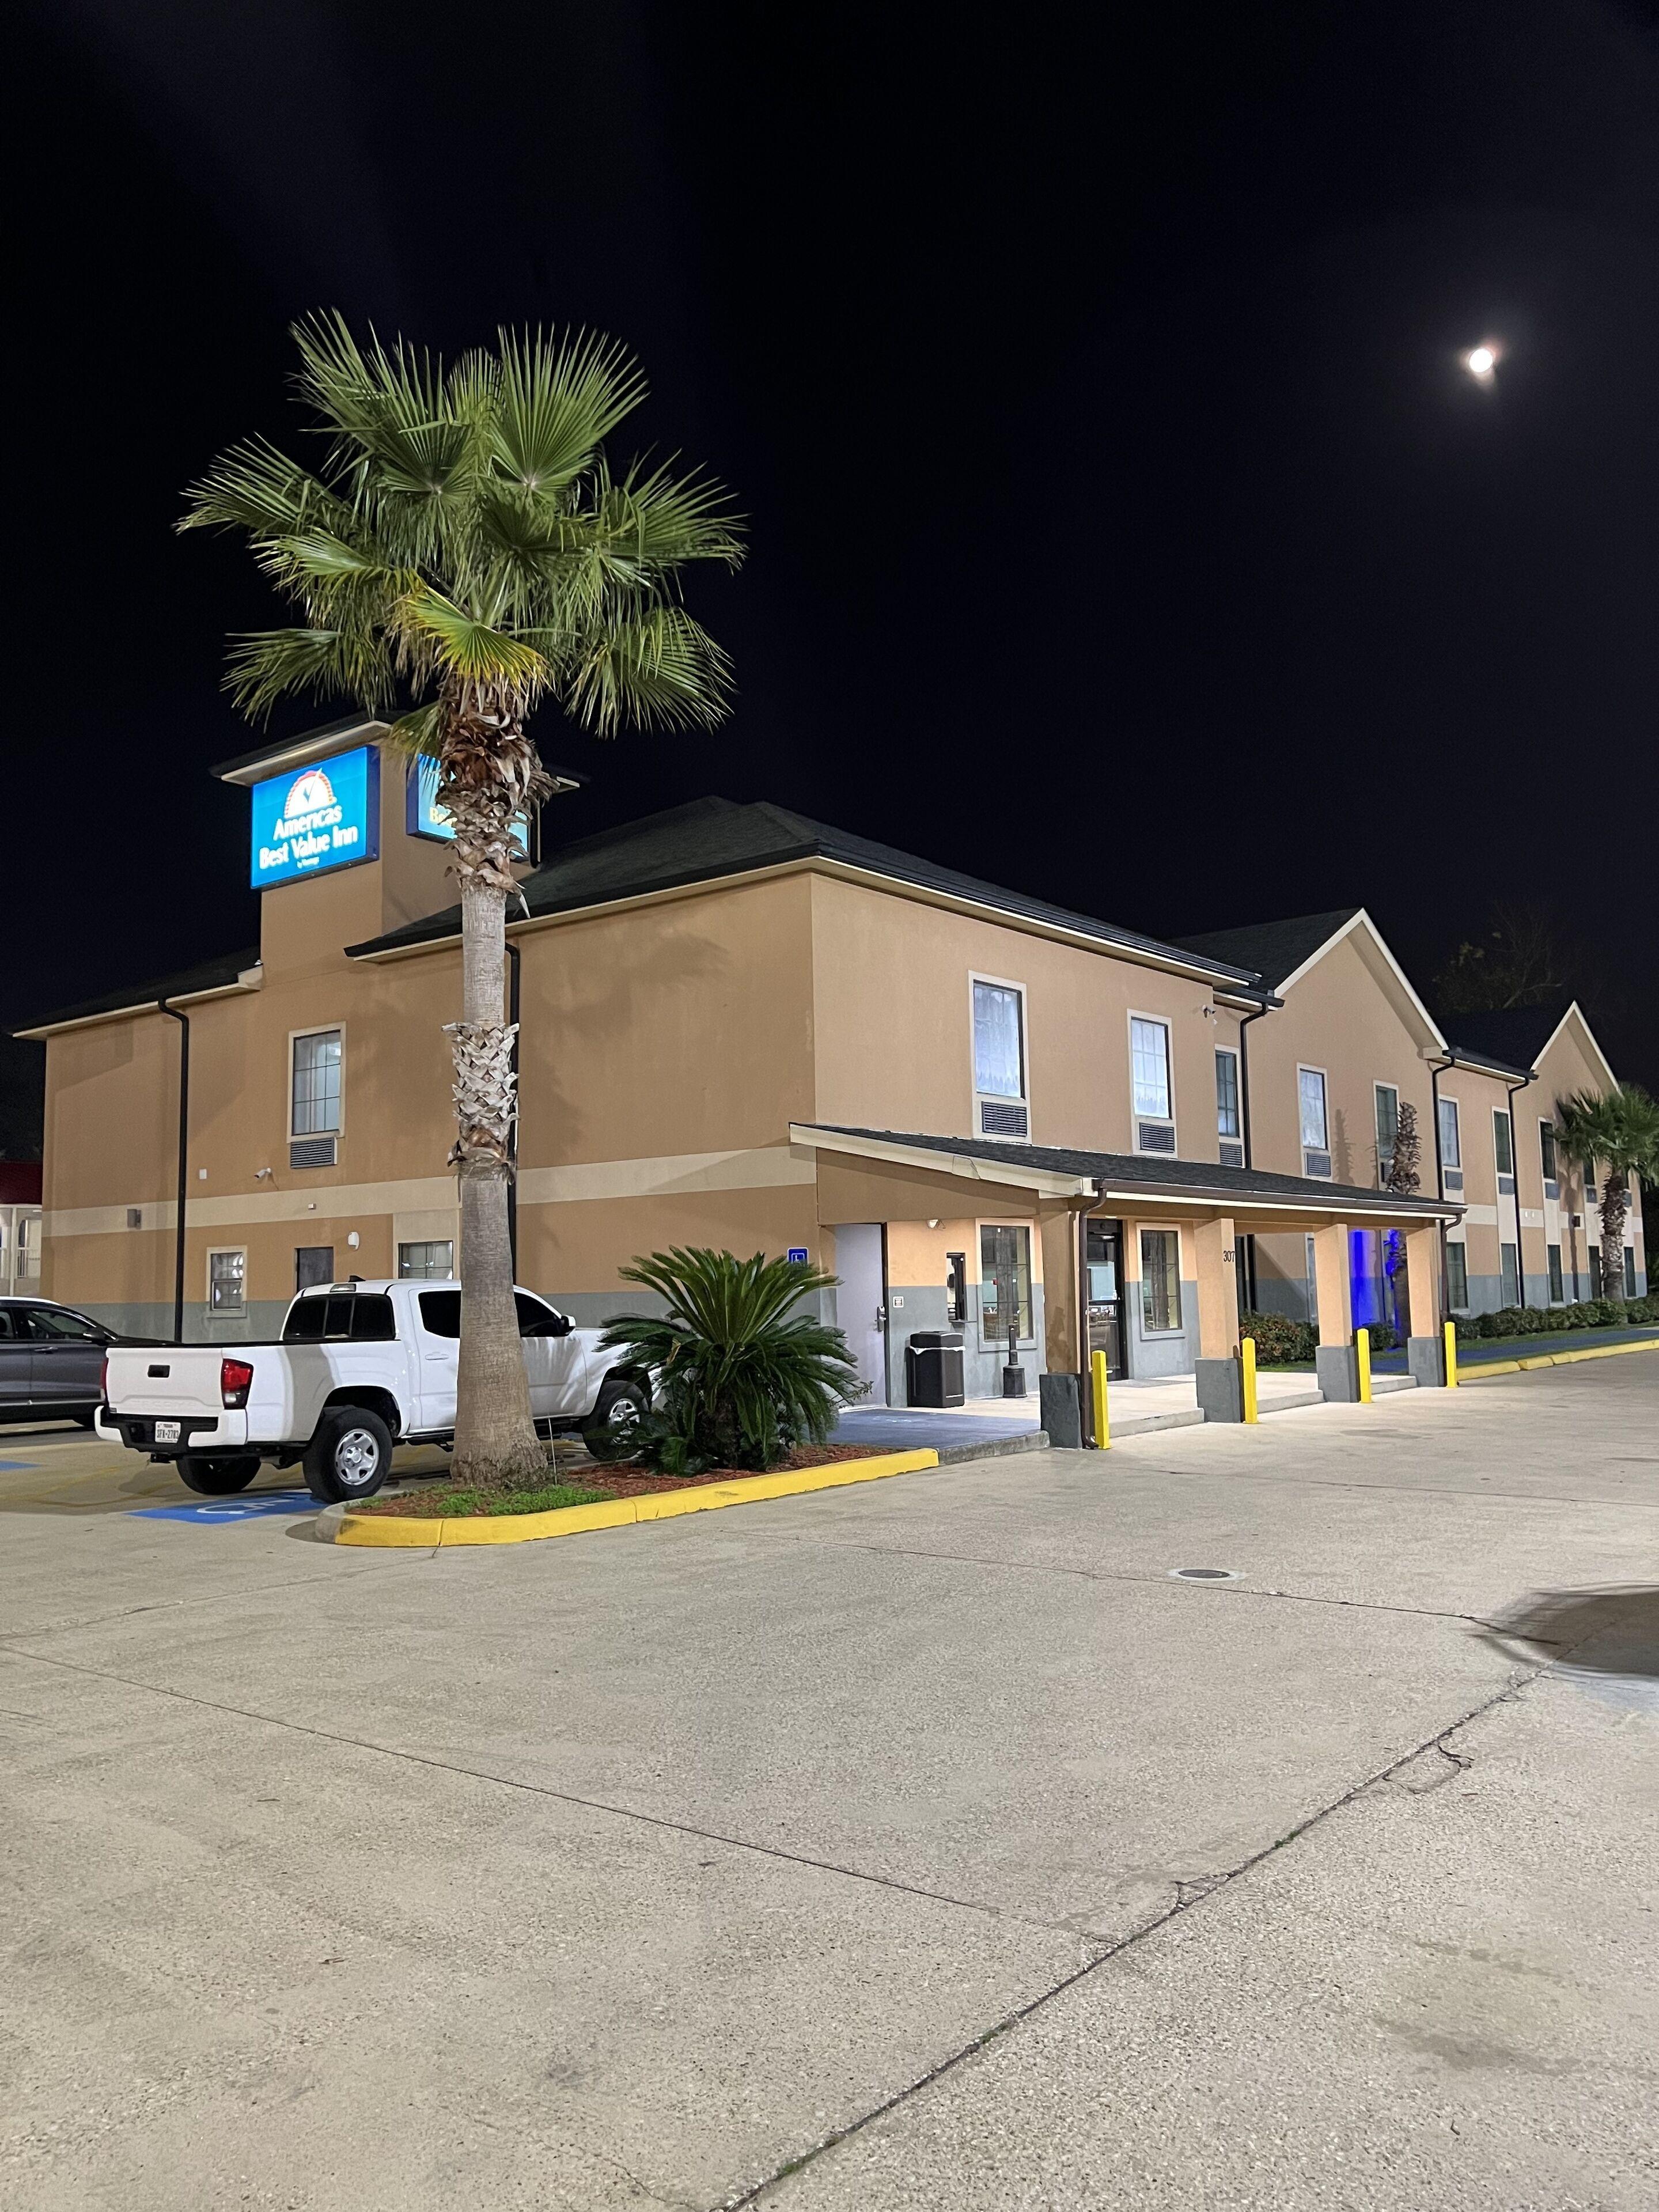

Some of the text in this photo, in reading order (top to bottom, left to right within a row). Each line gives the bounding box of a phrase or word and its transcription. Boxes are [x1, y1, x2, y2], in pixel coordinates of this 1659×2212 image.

[273, 805, 342, 840] Americas
[259, 842, 289, 869] Best
[290, 831, 331, 859] Value
[332, 825, 358, 848] Inn
[1223, 1250, 1236, 1262] 307
